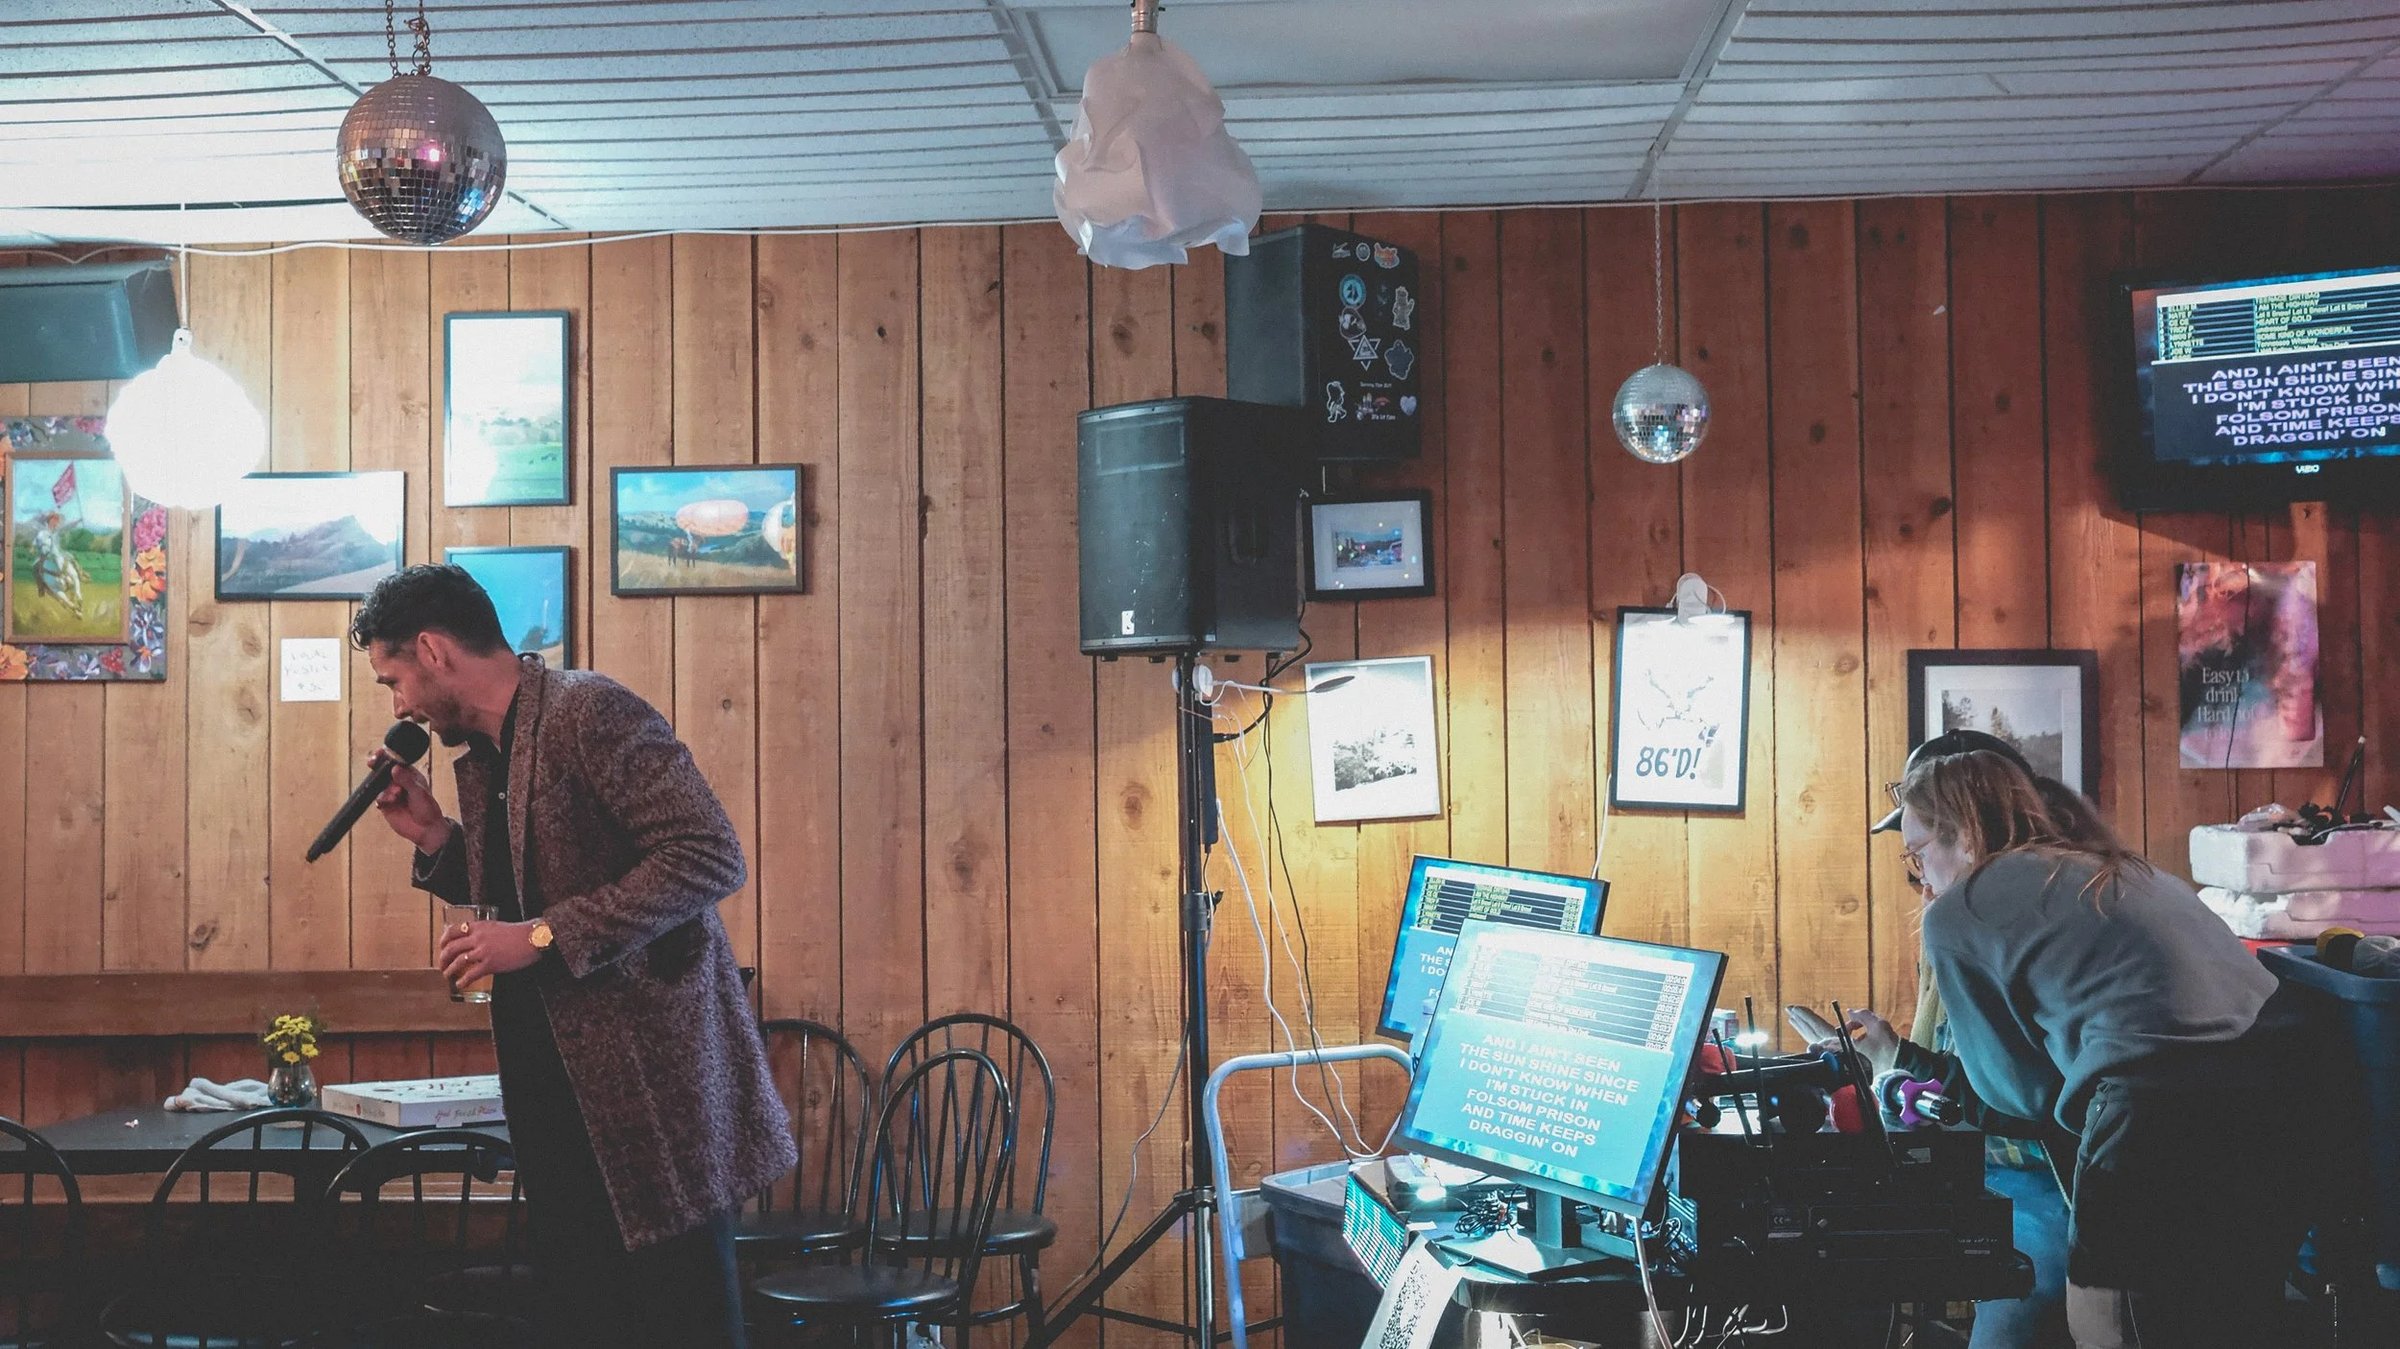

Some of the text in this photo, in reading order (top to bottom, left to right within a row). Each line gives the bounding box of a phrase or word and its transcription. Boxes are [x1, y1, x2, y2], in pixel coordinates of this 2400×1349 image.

[2212, 356, 2400, 380] AND I AIN'T SEEN
[2183, 381, 2228, 393] THE
[2232, 377, 2279, 390] SUN
[2285, 371, 2356, 385] SHINE
[2192, 394, 2198, 404] I
[2204, 389, 2272, 404] DON'T
[2277, 383, 2350, 398] KNOW
[2238, 392, 2381, 412] I'M STUCK IN
[2216, 403, 2400, 425] FOLSOM PRISON
[2215, 415, 2400, 436] AND TIME KEEPS
[2234, 427, 2386, 446] DRAGGIN' ON
[2203, 667, 2234, 687] Easy
[2198, 706, 2231, 722] Hard
[1636, 746, 1702, 780] 86'D!
[1420, 953, 1443, 965] THE
[1421, 965, 1425, 973] I
[1482, 1034, 1621, 1072] AND I AIN'T SEEN
[1459, 1043, 1640, 1093] THE SUN SHINE SINCE
[1459, 1058, 1629, 1106] I DON'T KNOW WHEN
[1486, 1078, 1589, 1112] I'M STUCK IN
[1467, 1088, 1602, 1131] FOLSOM PRISON
[1461, 1102, 1597, 1146] AND TIME KEEPS
[1468, 1119, 1578, 1158] DRAGGIN' ON
